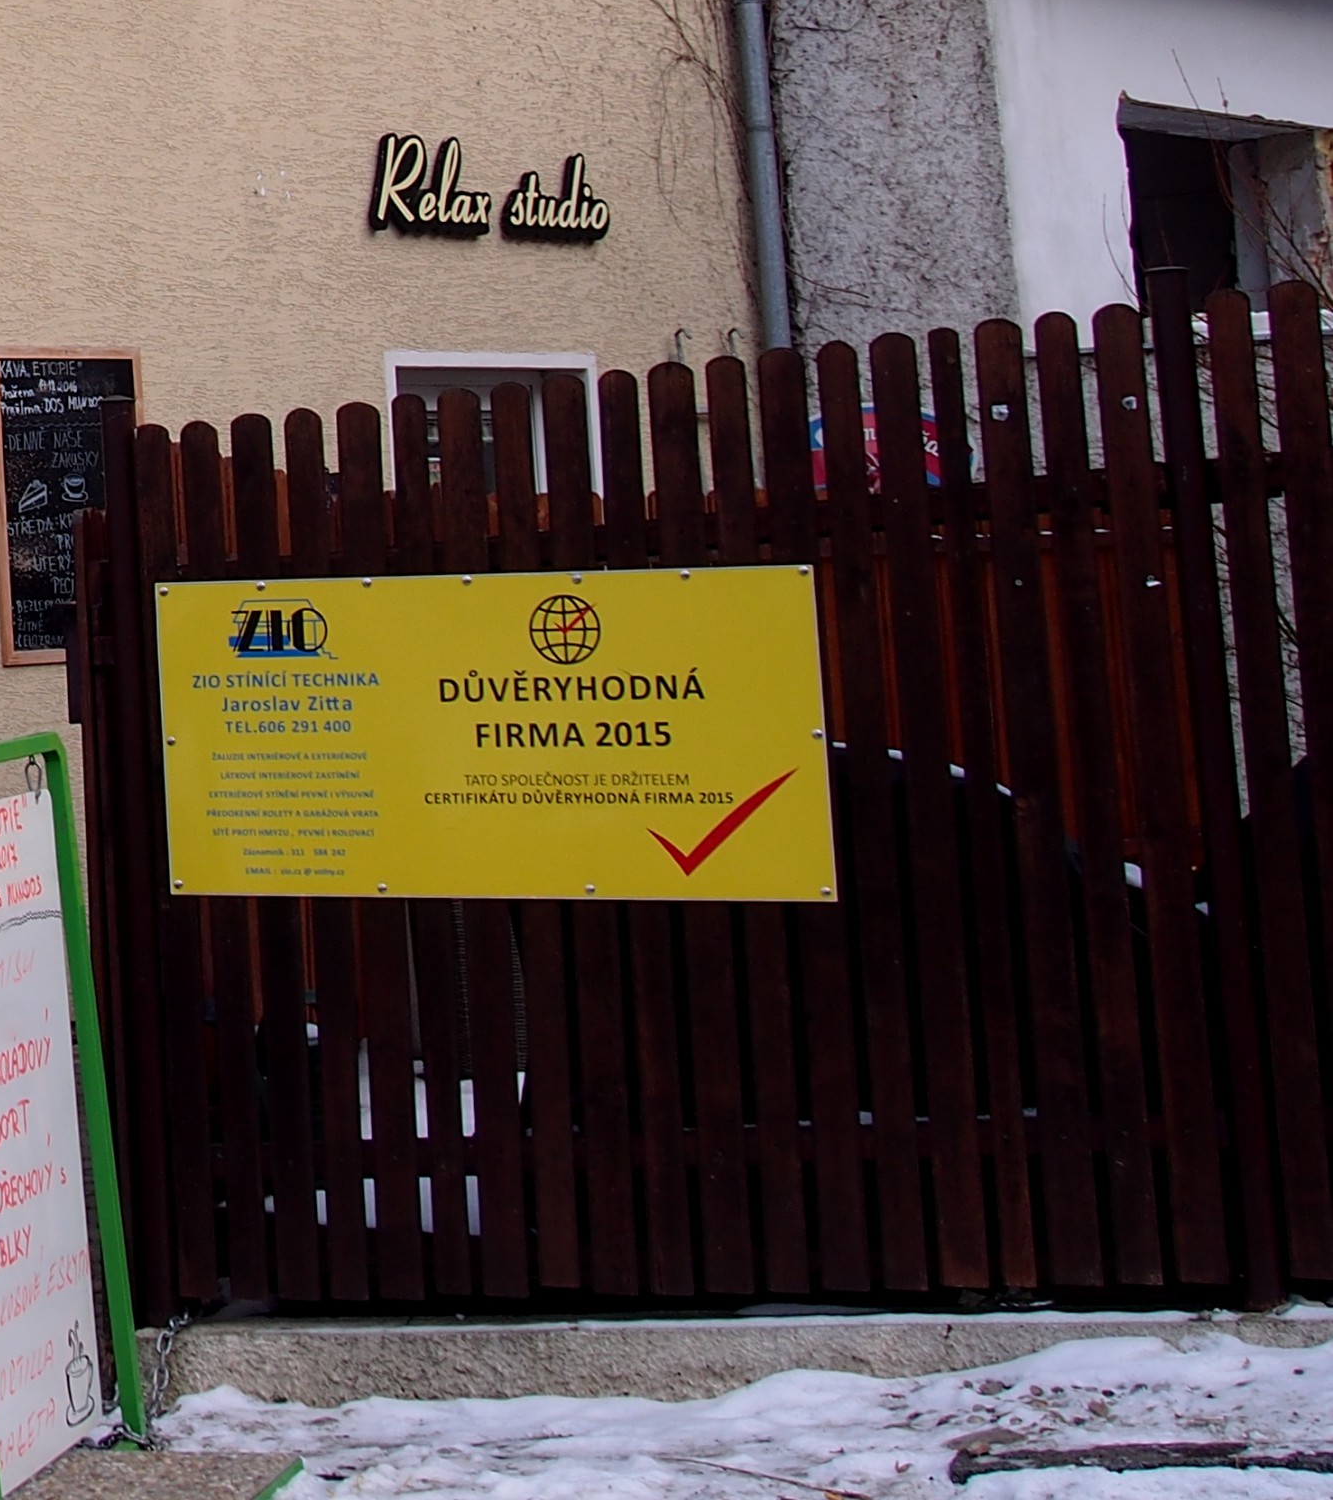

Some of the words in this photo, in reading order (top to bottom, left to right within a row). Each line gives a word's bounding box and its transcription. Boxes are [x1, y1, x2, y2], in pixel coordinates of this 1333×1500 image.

[372, 133, 490, 230] Relax
[504, 153, 609, 237] studio
[44, 398, 64, 413] DOS
[231, 608, 328, 652] ZIO
[192, 675, 220, 688] ZIO
[226, 671, 286, 688] STÍNÍCÍ
[292, 673, 379, 688] TECHNIKA
[439, 667, 706, 703] DŮVĚRYHODNÁ
[222, 696, 300, 712] Jaroslav
[308, 697, 352, 711] Zitta
[292, 721, 318, 732] 291
[323, 720, 351, 732] 400
[475, 722, 585, 748] FIRMA
[595, 721, 672, 747] 2015
[212, 752, 244, 761] ŽALUZIE
[247, 752, 301, 761] INTERIÉROVÉ
[311, 752, 367, 761] EXTERIÉROVÉ
[221, 771, 256, 780] LÁTKOVÉ
[259, 771, 313, 779] INTERIÉROVÉ
[316, 770, 359, 779] ZASTÍNĚNÍ
[464, 774, 497, 787] TATO
[502, 771, 591, 787] SPOLEČNOST
[593, 773, 606, 787] JE
[612, 771, 690, 786] DRŽITELEM
[209, 790, 263, 799] EXTERIÉROVÉ
[266, 790, 298, 798] STÍNĚNÍ
[301, 790, 328, 798] PEVNÉ
[335, 790, 374, 798] VÝSUVNÉ
[425, 789, 517, 805] CERTIFIKÁTU
[522, 788, 641, 804] DŮVĚRYHODNÁ
[645, 792, 695, 804] FIRMA
[699, 791, 734, 804] 2015
[207, 809, 260, 817] PŘEDOKENNÍ
[304, 809, 350, 818] GARÁŽOVÁ
[332, 828, 374, 837] ROLOVACÍ
